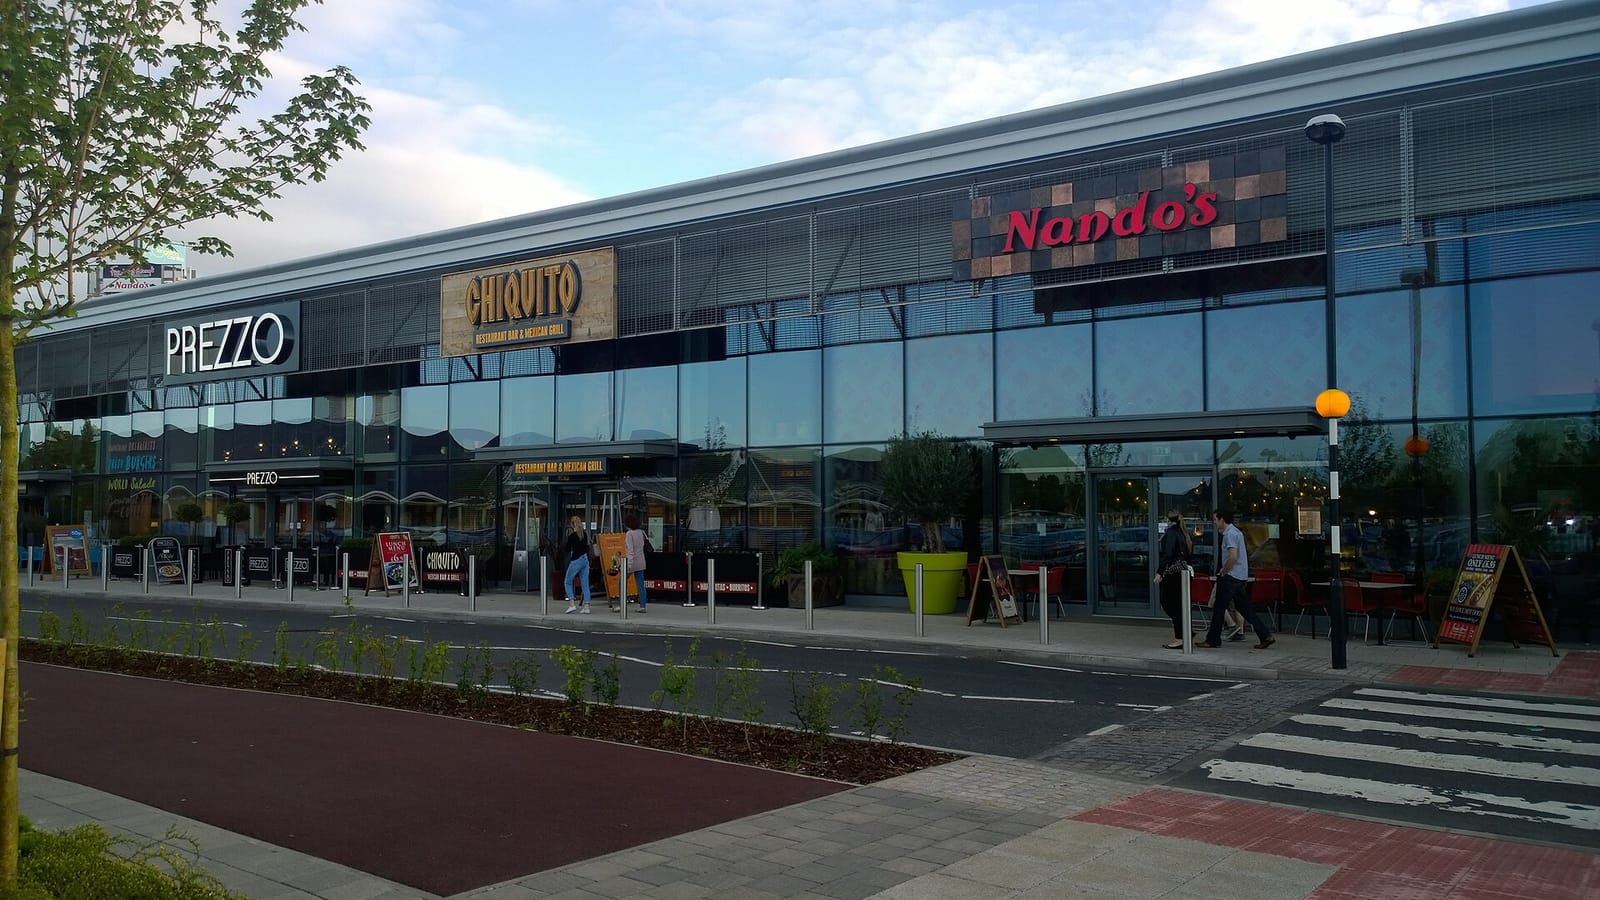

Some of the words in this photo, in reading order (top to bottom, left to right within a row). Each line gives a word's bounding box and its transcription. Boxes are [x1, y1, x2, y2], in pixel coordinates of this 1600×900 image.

[1002, 182, 1217, 252] Nando's
[114, 281, 149, 289] Nando's
[466, 262, 577, 325] CHIQUITO
[475, 332, 507, 345] RESTAURANT
[508, 330, 519, 341] BAR
[525, 326, 548, 338] MEXICAN
[549, 324, 564, 335] GRILL
[167, 312, 284, 375] PREZZO
[515, 462, 546, 474] RESTAURANT
[547, 462, 557, 473] BAR
[558, 462, 563, 473] &
[563, 461, 586, 473] MEXICAN
[587, 460, 603, 471] GRILL
[247, 471, 278, 485] PREZZO
[249, 559, 268, 568] PREZZO
[426, 552, 460, 570] CHIQUITO
[729, 583, 750, 592] BURRITOS
